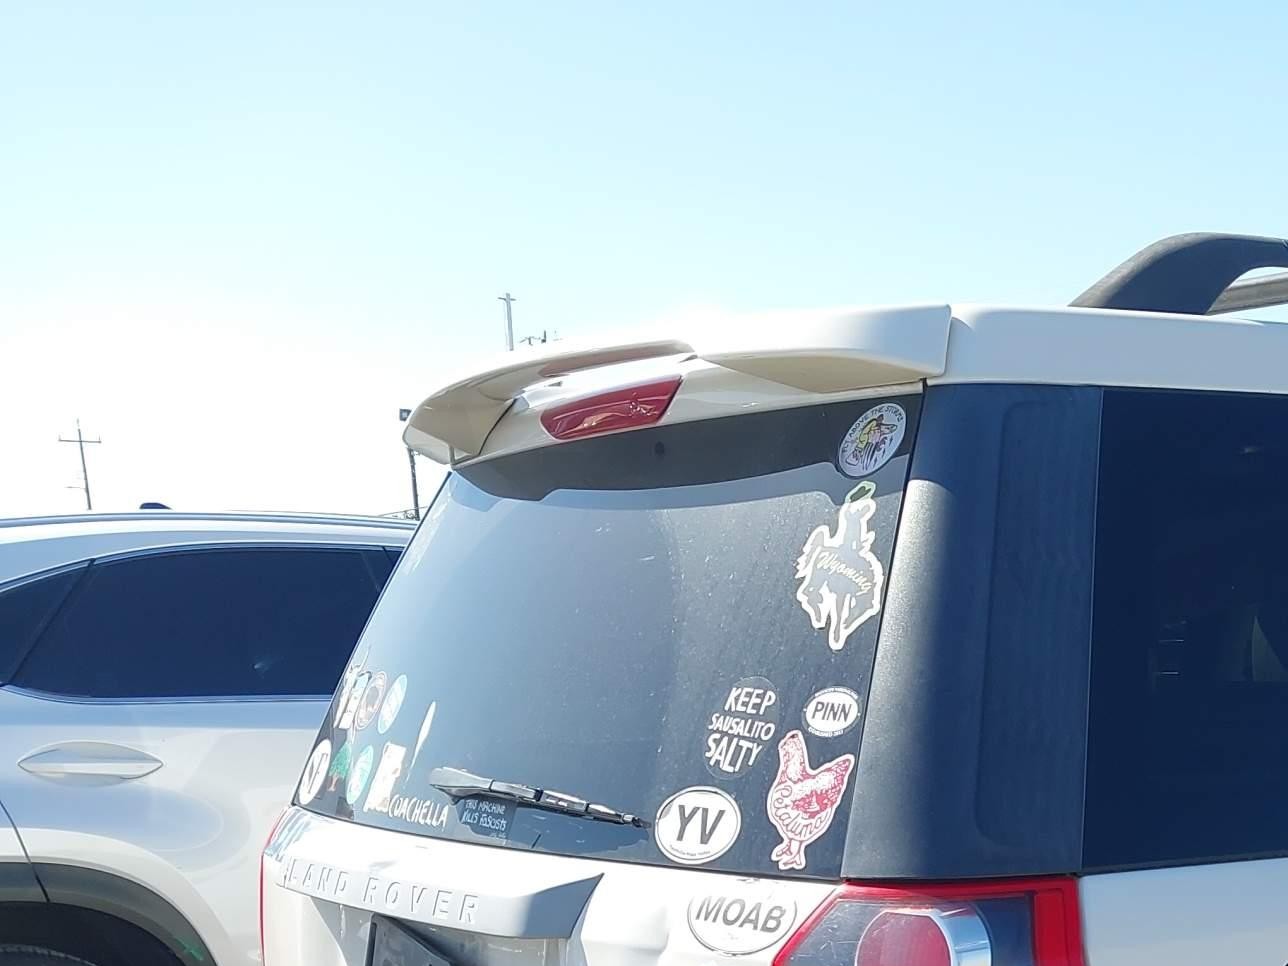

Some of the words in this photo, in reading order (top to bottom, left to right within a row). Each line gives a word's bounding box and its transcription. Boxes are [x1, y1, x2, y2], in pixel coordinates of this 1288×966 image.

[849, 415, 868, 438] ABOVE
[816, 551, 872, 596] Wyoming
[724, 687, 776, 715] KEEP
[811, 701, 852, 722] PINN
[708, 713, 776, 741] SAUSALITO
[704, 732, 763, 773] SALTY
[388, 794, 450, 832] COACHELLA
[478, 800, 506, 815] MACHINE
[676, 804, 726, 845] YV
[288, 858, 349, 896] LAND
[363, 876, 480, 924] ROVER
[695, 895, 787, 933] MOAB
